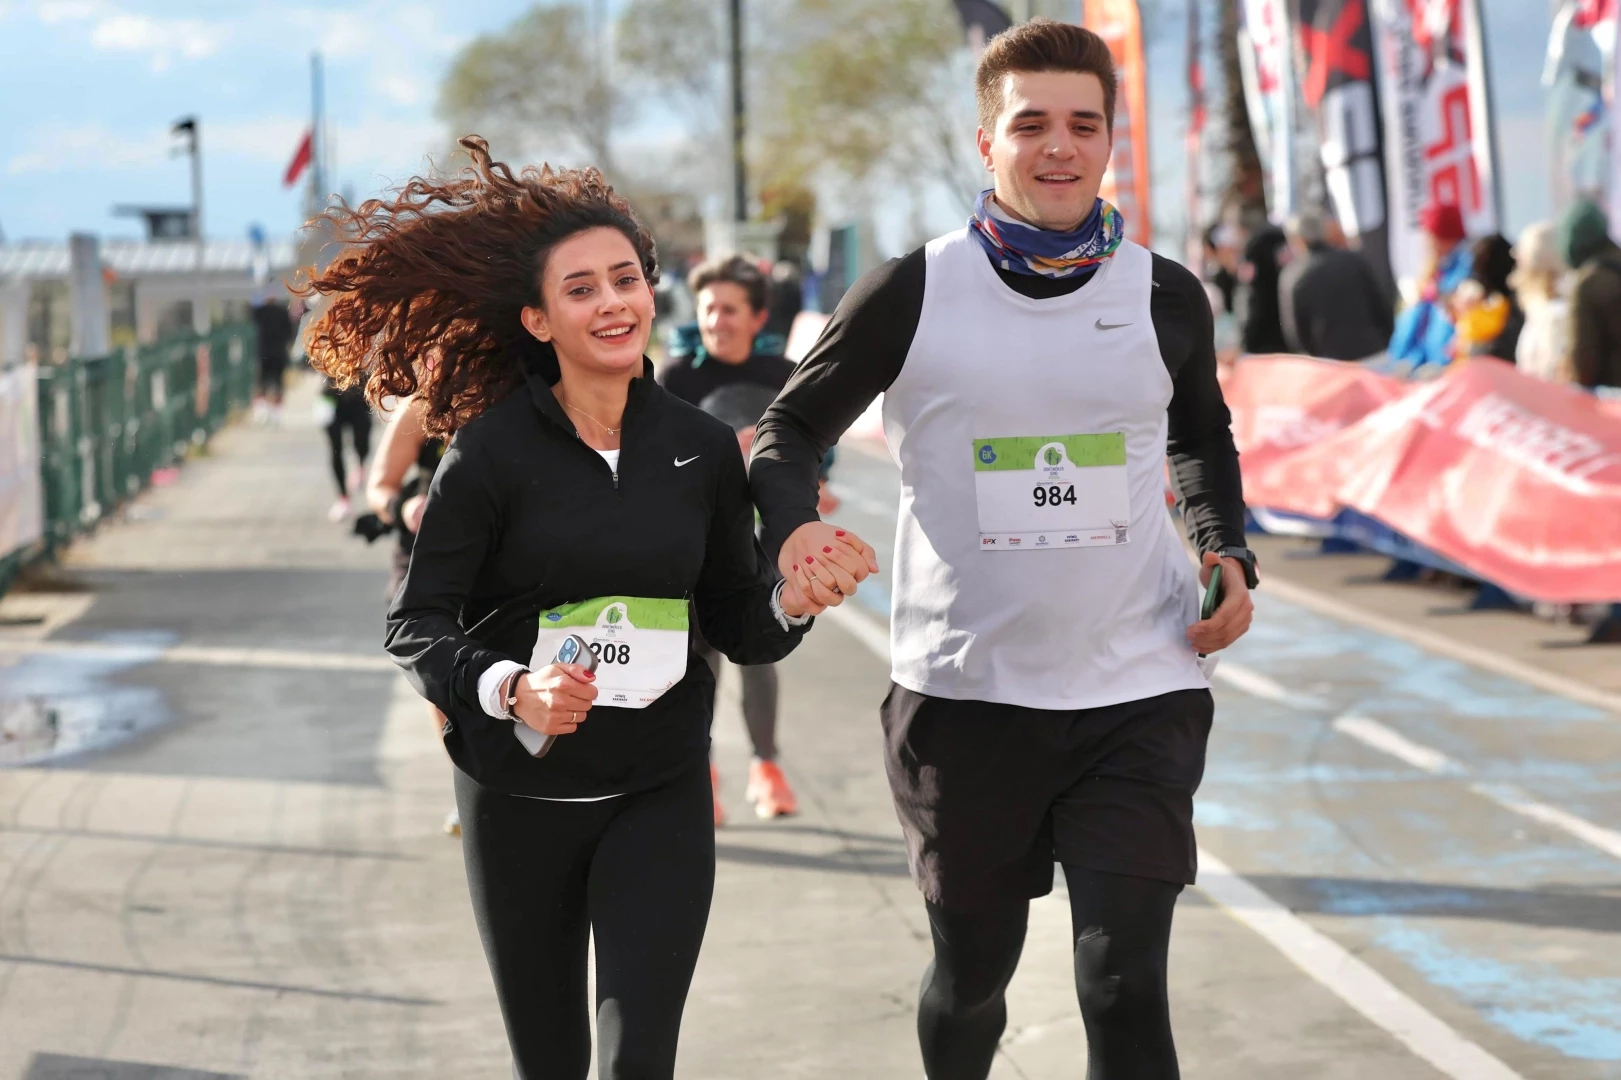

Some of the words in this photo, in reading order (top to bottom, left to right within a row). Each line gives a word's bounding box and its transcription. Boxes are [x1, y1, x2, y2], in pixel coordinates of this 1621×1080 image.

[982, 450, 992, 460] 6K
[1033, 485, 1077, 507] 984
[589, 642, 630, 664] 208
